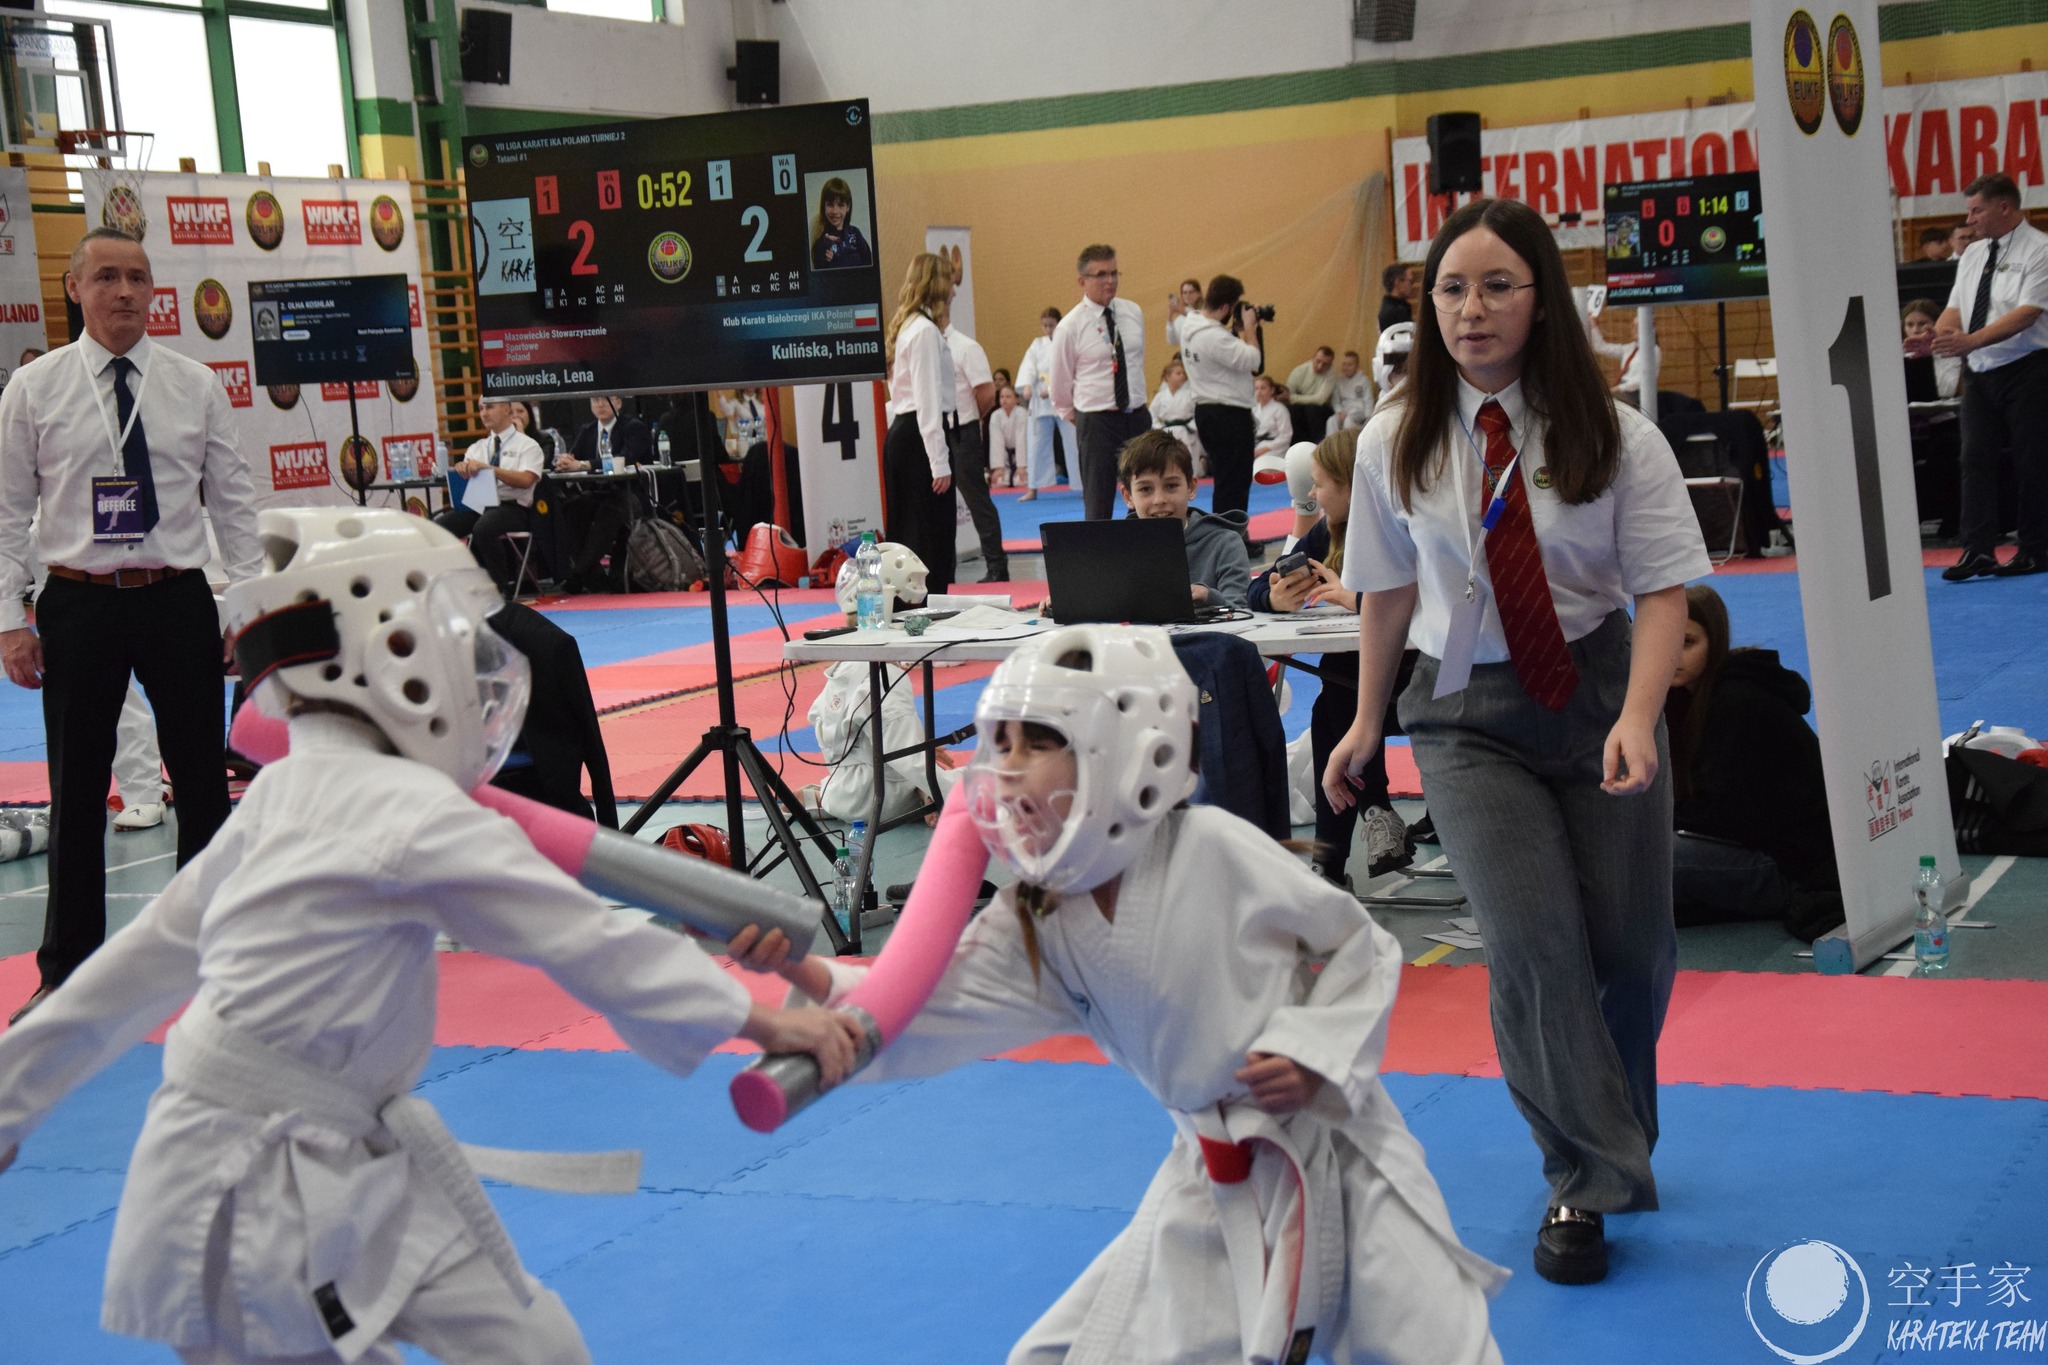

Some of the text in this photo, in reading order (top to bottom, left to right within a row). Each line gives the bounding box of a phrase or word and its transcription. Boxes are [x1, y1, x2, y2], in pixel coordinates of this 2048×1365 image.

[506, 141, 522, 150] LIGA
[522, 139, 549, 149] KARATE
[550, 138, 562, 146] IKA
[562, 135, 590, 145] POLAND
[592, 132, 620, 142] TURNIEJ
[620, 131, 626, 141] 2
[496, 153, 528, 164] Tatami #1
[715, 164, 723, 172] IP
[778, 158, 790, 167] WA
[1404, 97, 2048, 242] INERNATIO KARA
[637, 170, 693, 210] 0:52
[715, 175, 724, 196] 1
[779, 169, 791, 191] 0
[543, 189, 551, 210] 1
[604, 184, 615, 205] 0
[170, 202, 228, 224] WUKF
[305, 205, 358, 225] WUKF
[1699, 195, 1729, 217] 1:14
[498, 217, 526, 251] 空
[740, 205, 773, 263] 2
[1658, 218, 1675, 247] 0
[567, 219, 599, 276] 2
[733, 275, 739, 284] A
[769, 272, 780, 281] AC
[788, 271, 799, 280] AH
[560, 288, 566, 297] A
[595, 285, 605, 294] AC
[613, 284, 624, 293] AH
[732, 286, 741, 295] K1
[751, 284, 761, 293] K2
[770, 283, 781, 292] KC
[789, 281, 800, 290] KH
[559, 298, 568, 307] K1
[578, 297, 588, 306] K2
[596, 295, 606, 304] KC
[614, 294, 625, 303] KH
[723, 309, 853, 327] Klub Karate Białobrzegi IKA Poland
[827, 319, 854, 330] Poland
[504, 325, 607, 341] Mazowieckie Stowarzyszenie
[505, 342, 539, 353] Sportowe
[506, 351, 531, 362] Poland
[771, 339, 879, 360] Kulińska, Hanna
[486, 368, 594, 388] Kalinowska, Lena
[822, 382, 860, 461] 4
[274, 447, 325, 470] WUKF
[1828, 295, 1892, 602] 1
[97, 499, 137, 512] REFEREE
